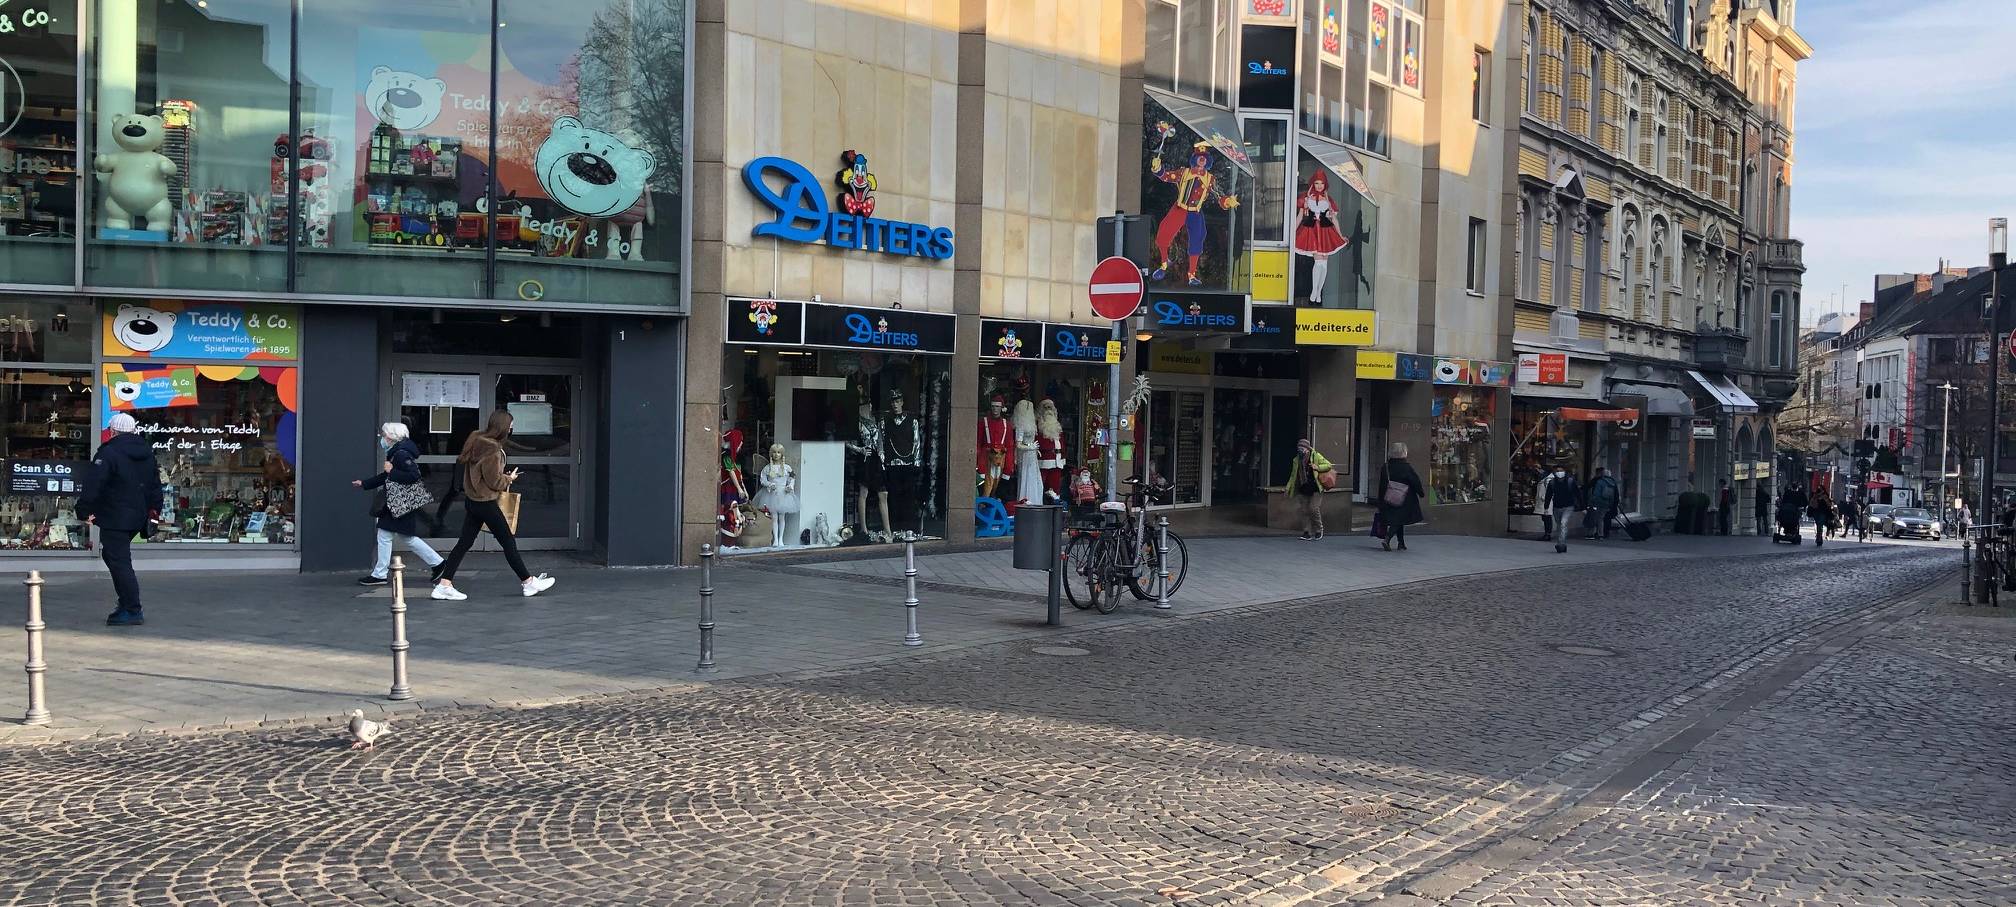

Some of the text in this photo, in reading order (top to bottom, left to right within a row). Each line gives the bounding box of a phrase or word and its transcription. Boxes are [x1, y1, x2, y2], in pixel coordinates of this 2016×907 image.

[22, 8, 57, 27] Co.
[449, 93, 510, 117] Tedy
[585, 229, 598, 247] &
[187, 311, 291, 331] Teddy & Co.
[619, 330, 625, 341] 1
[844, 313, 918, 346] DEITERS
[187, 334, 266, 344] Verantwortlich für
[204, 344, 250, 354] Spielwaren
[269, 346, 290, 354] 1895
[147, 380, 170, 388] Teddy
[225, 423, 260, 437] Teddy
[152, 438, 174, 451] auf
[177, 438, 196, 449] der
[211, 438, 242, 453] Etage
[13, 463, 72, 474] Scan & Go
